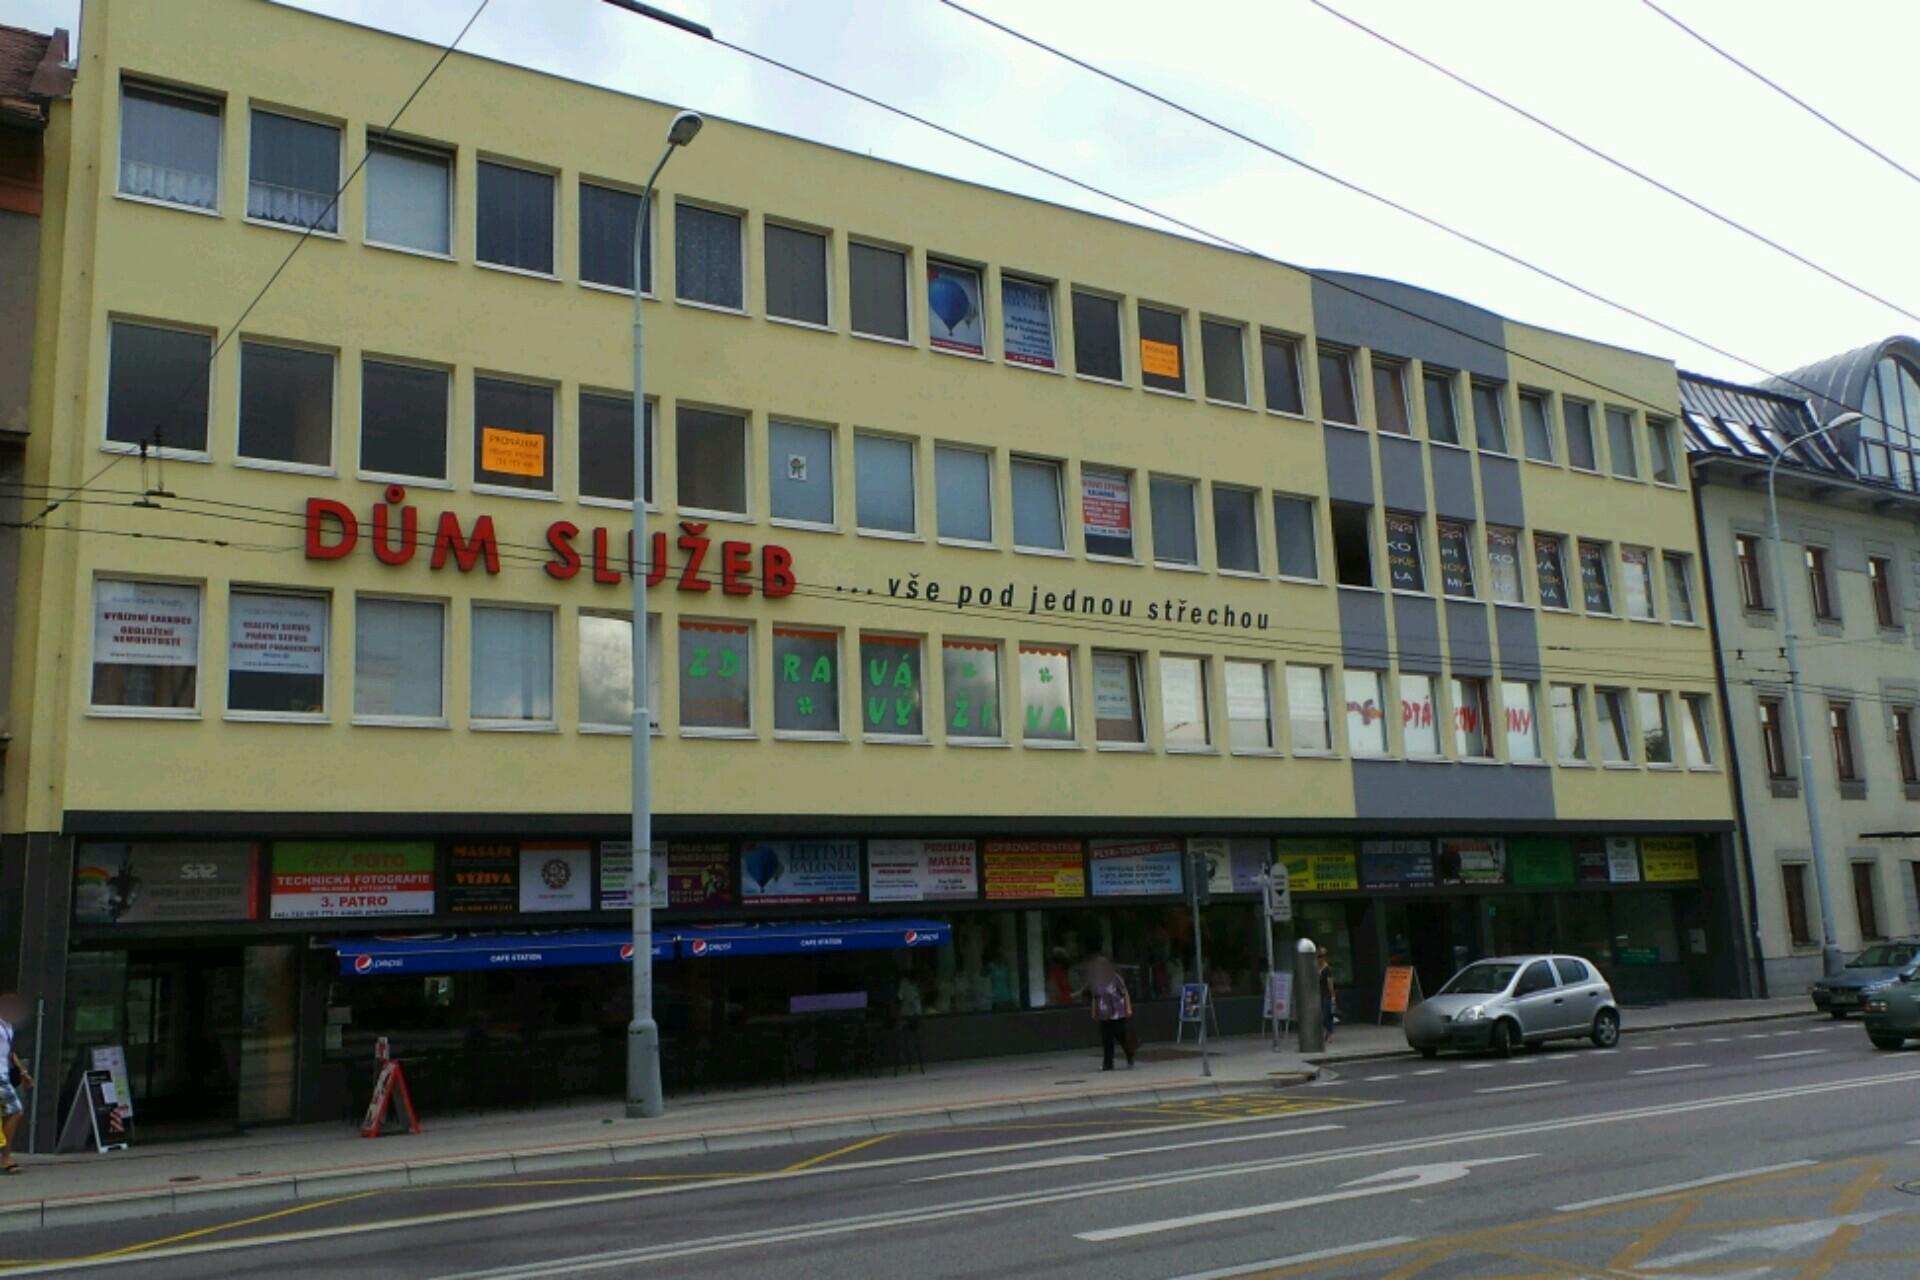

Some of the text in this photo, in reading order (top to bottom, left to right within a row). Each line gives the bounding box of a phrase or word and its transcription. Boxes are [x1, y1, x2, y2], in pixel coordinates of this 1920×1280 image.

[305, 484, 797, 598] DŮM SLUŽEB
[888, 572, 941, 602] vše
[957, 582, 1015, 609] pod
[1028, 584, 1133, 616] jednou
[1146, 597, 1270, 631] střechou
[354, 872, 430, 884] FOTOGRAFIE
[320, 895, 388, 908] 3. PATRO
[917, 932, 939, 944] pepsi
[707, 941, 732, 953] pepsi
[373, 958, 403, 970] pepsi
